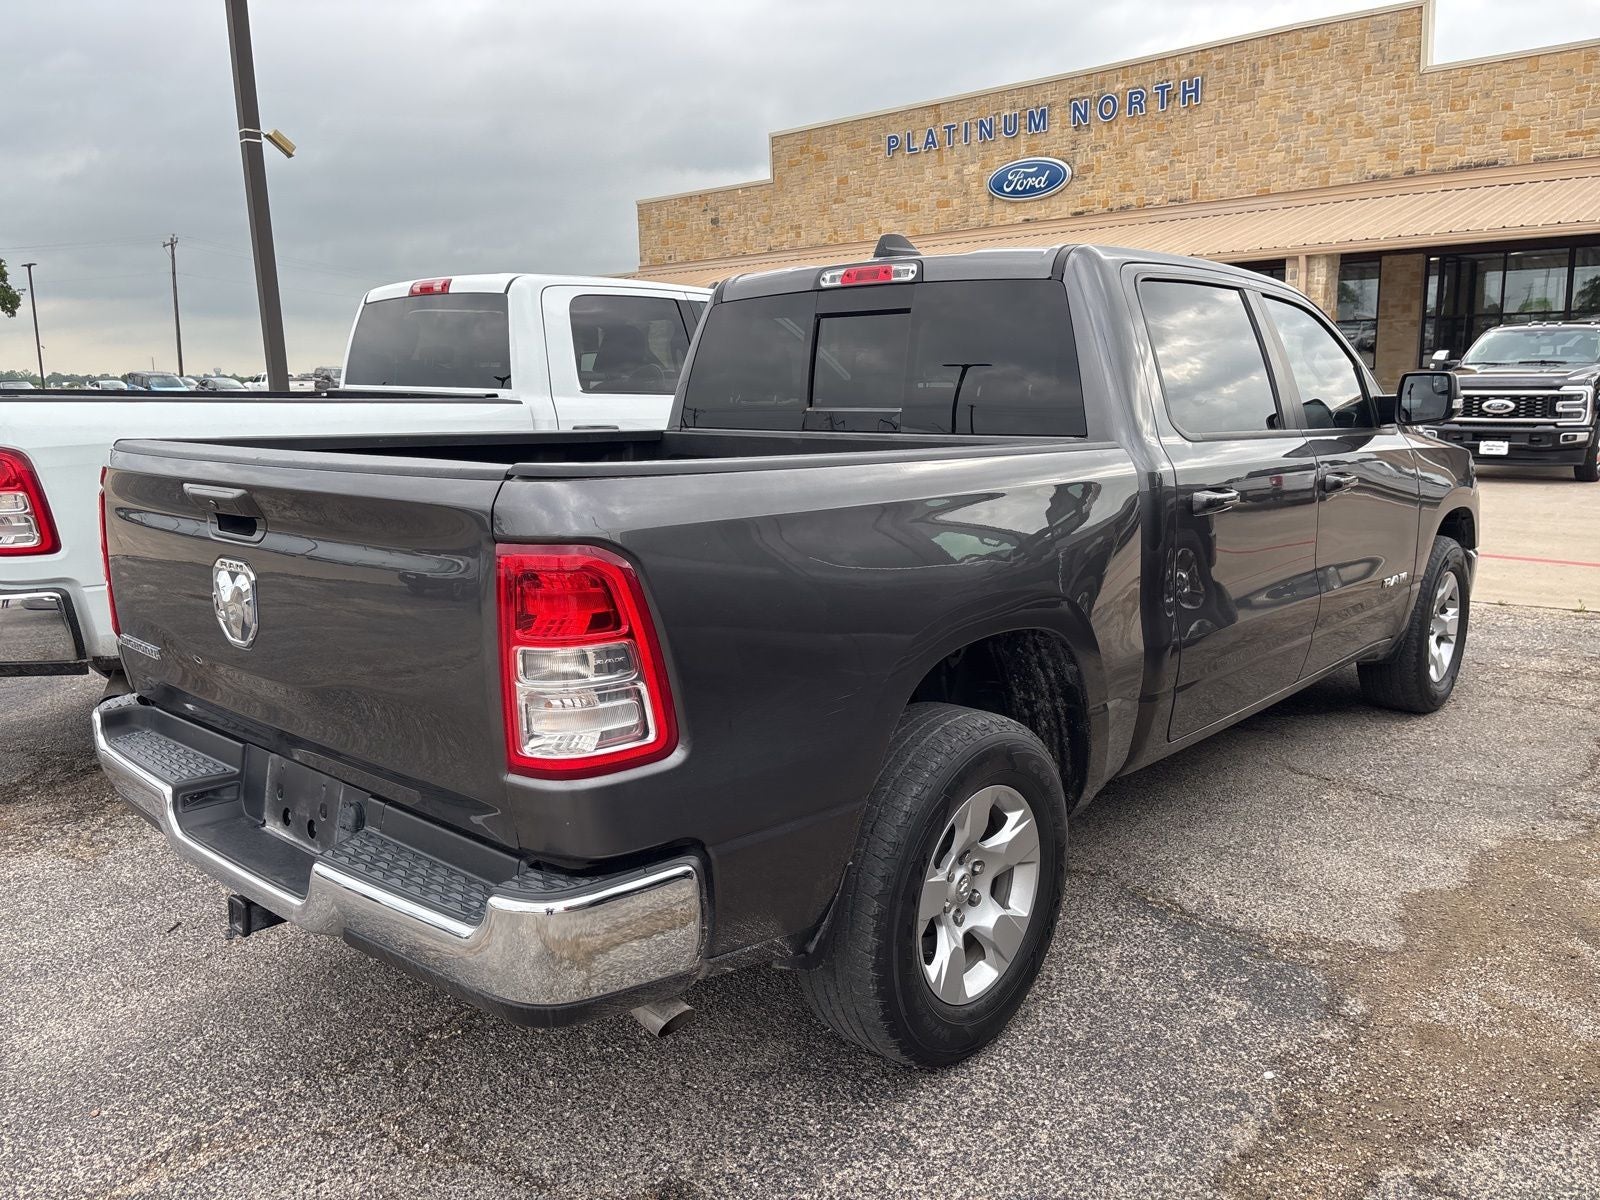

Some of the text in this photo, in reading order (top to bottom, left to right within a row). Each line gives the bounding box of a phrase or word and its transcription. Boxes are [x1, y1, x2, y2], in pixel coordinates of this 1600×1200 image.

[886, 76, 1201, 157] PLATINUM NORTH
[1003, 167, 1050, 192] Ford
[220, 560, 244, 572] RAM
